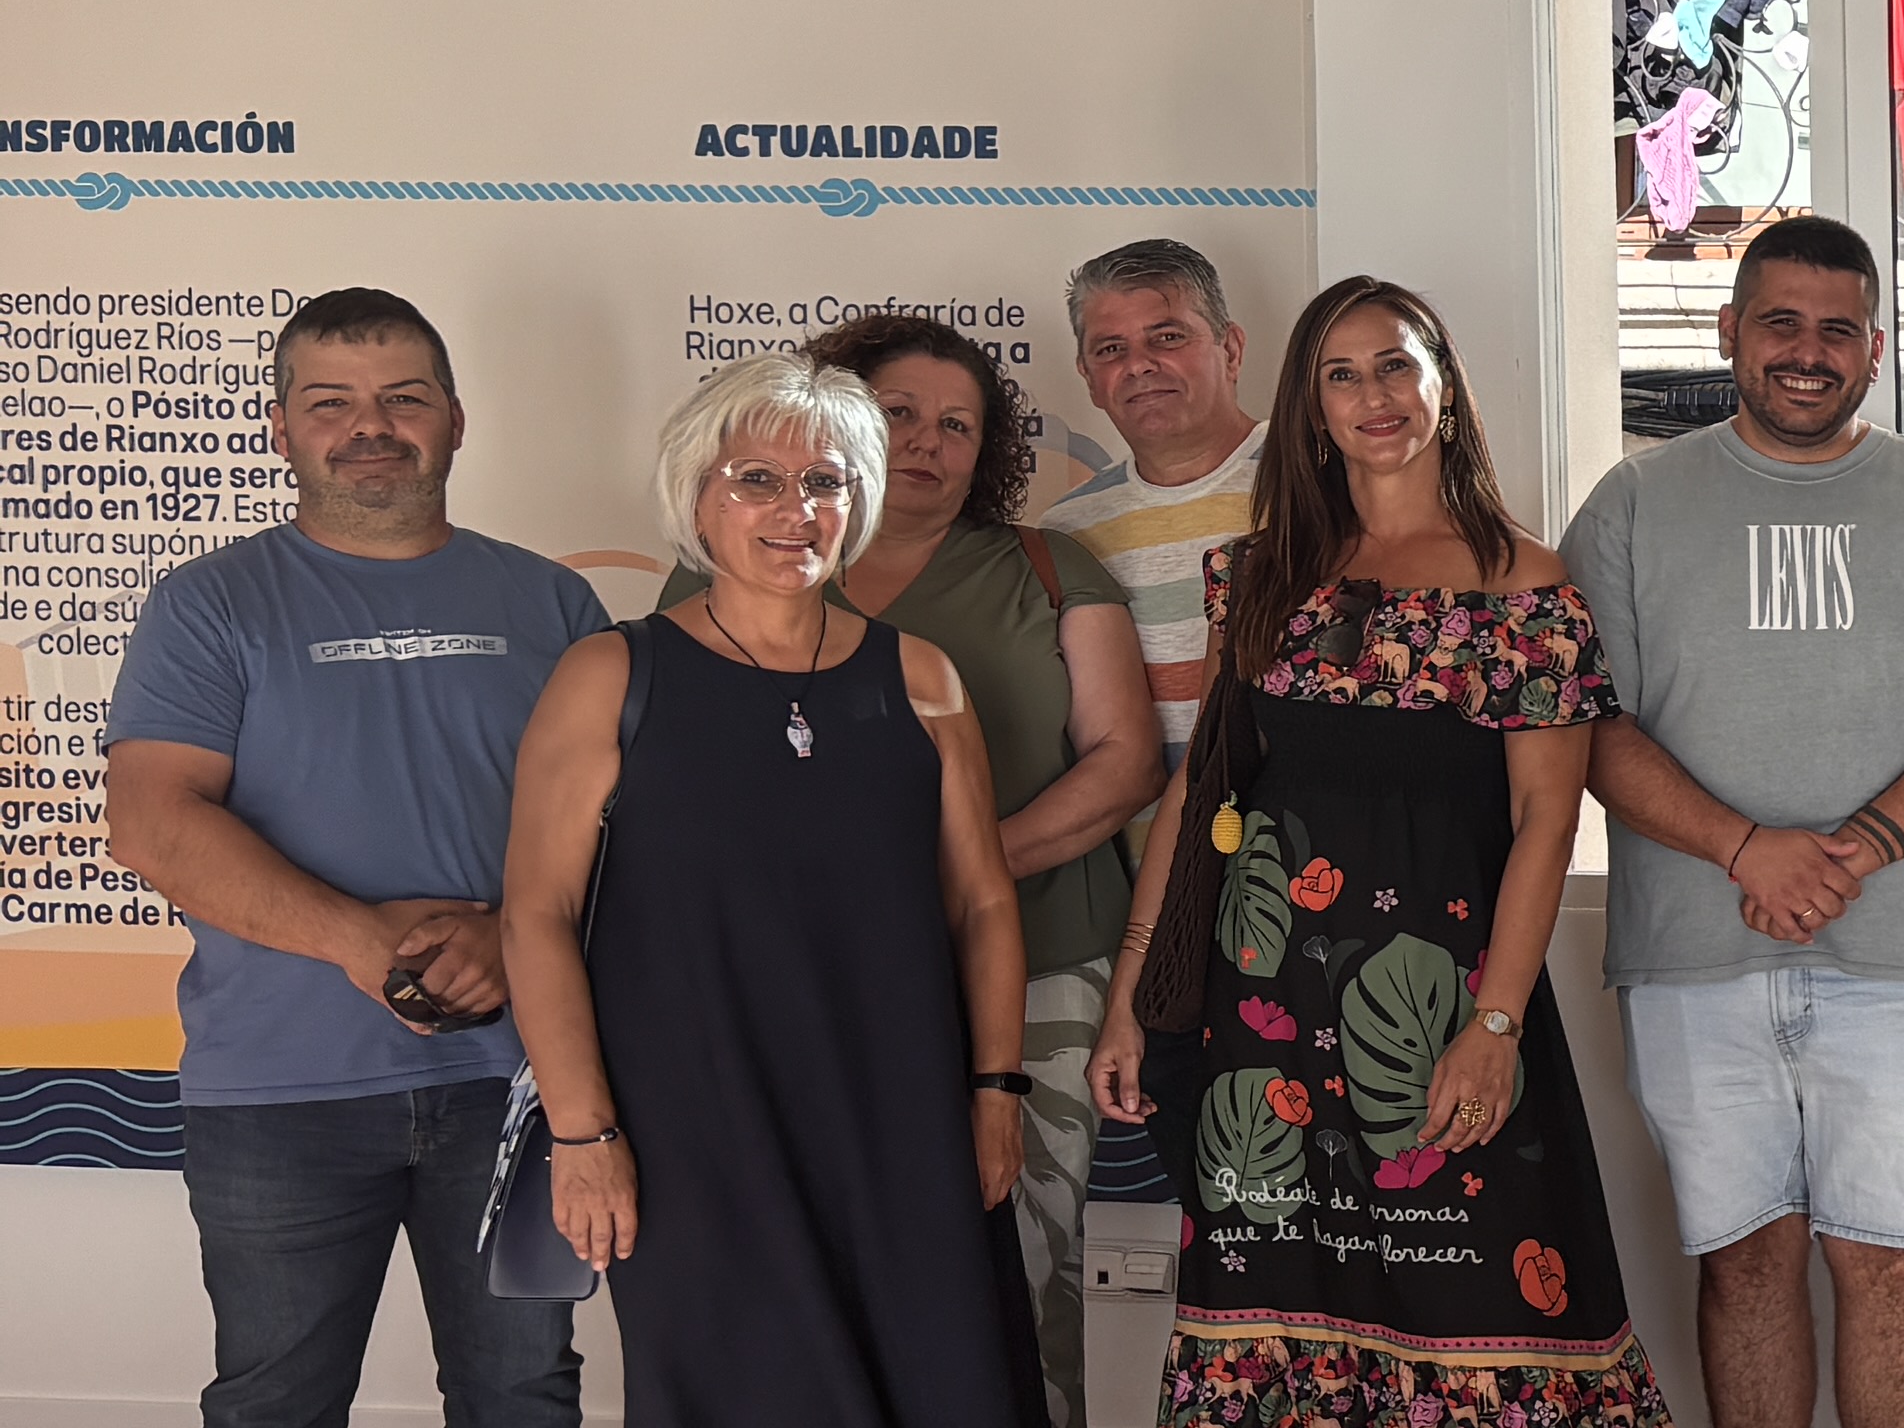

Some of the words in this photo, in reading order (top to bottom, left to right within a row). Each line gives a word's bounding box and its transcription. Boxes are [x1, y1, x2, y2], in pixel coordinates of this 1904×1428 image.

[695, 124, 998, 159] ACTUALIDADE
[0, 286, 90, 315] sendo
[100, 287, 264, 323] presidente
[689, 294, 781, 327] Hoxe,
[789, 302, 807, 324] a
[985, 297, 1024, 327] de
[0, 320, 149, 358] Rodríguez
[157, 322, 222, 351] Ríos
[37, 355, 131, 384] Daniel
[106, 396, 124, 418] o
[132, 390, 235, 419] Pósito
[59, 422, 98, 452] de
[106, 424, 220, 454] Rianxo
[0, 456, 34, 485] al
[42, 459, 154, 494] propio,
[160, 465, 222, 494] que
[2, 491, 93, 520] mado
[100, 498, 138, 520] en
[146, 493, 227, 522] 1927.
[112, 527, 205, 565] supón
[3, 564, 39, 587] na
[35, 599, 52, 621] e
[59, 592, 96, 622] da
[431, 638, 497, 652] ZONE
[67, 735, 84, 756] e
[62, 768, 108, 790] ev
[1, 796, 108, 830] gresiv
[33, 861, 73, 890] de
[2, 894, 113, 924] Carme
[120, 897, 160, 926] de
[1331, 1187, 1359, 1210] de
[1209, 1226, 1261, 1251] que
[1272, 1215, 1303, 1242] te
[1314, 1219, 1377, 1262] hagan
